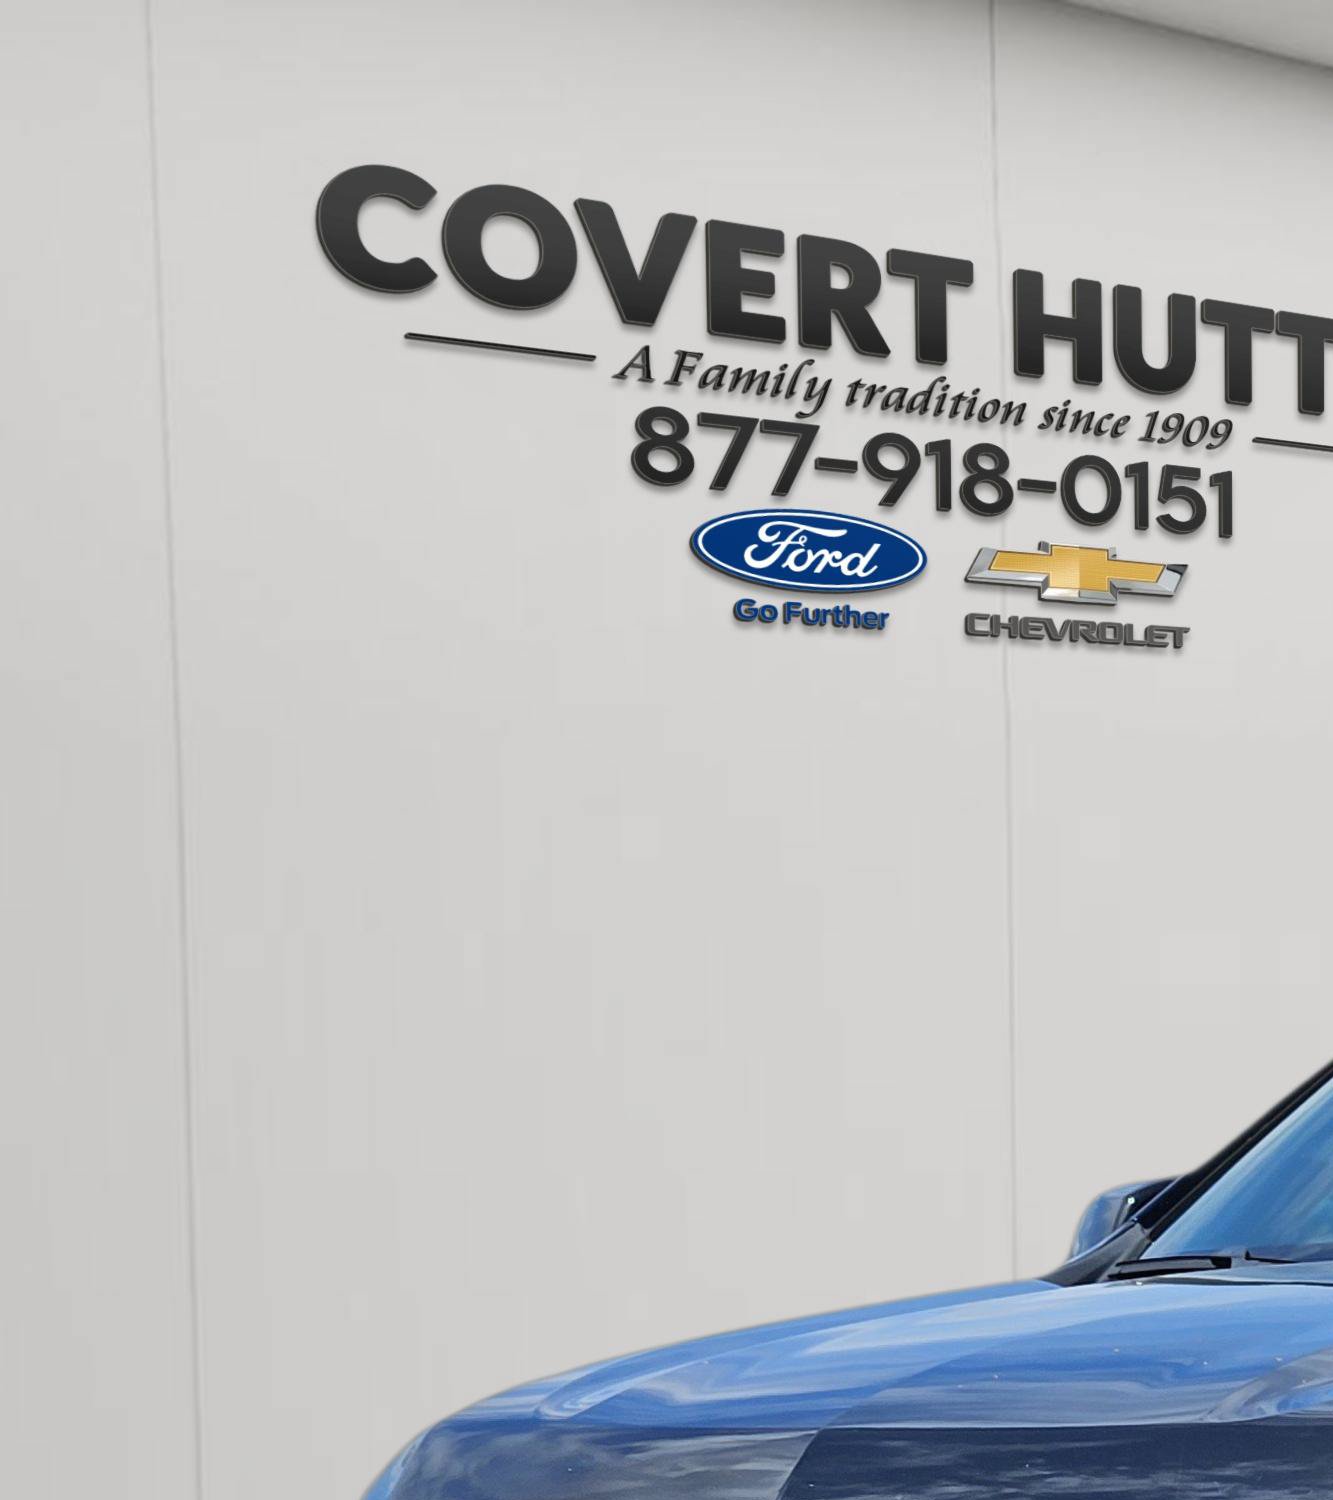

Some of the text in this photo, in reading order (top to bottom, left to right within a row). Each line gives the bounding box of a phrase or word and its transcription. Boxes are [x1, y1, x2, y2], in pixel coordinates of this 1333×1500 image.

[315, 165, 973, 367] COVERT
[612, 345, 1233, 450] A Family tradition since 1909
[631, 406, 1233, 540] 877-918-0151
[743, 519, 882, 578] Ford
[733, 599, 890, 631] Go Further
[964, 613, 1191, 649] CHEVROLET
